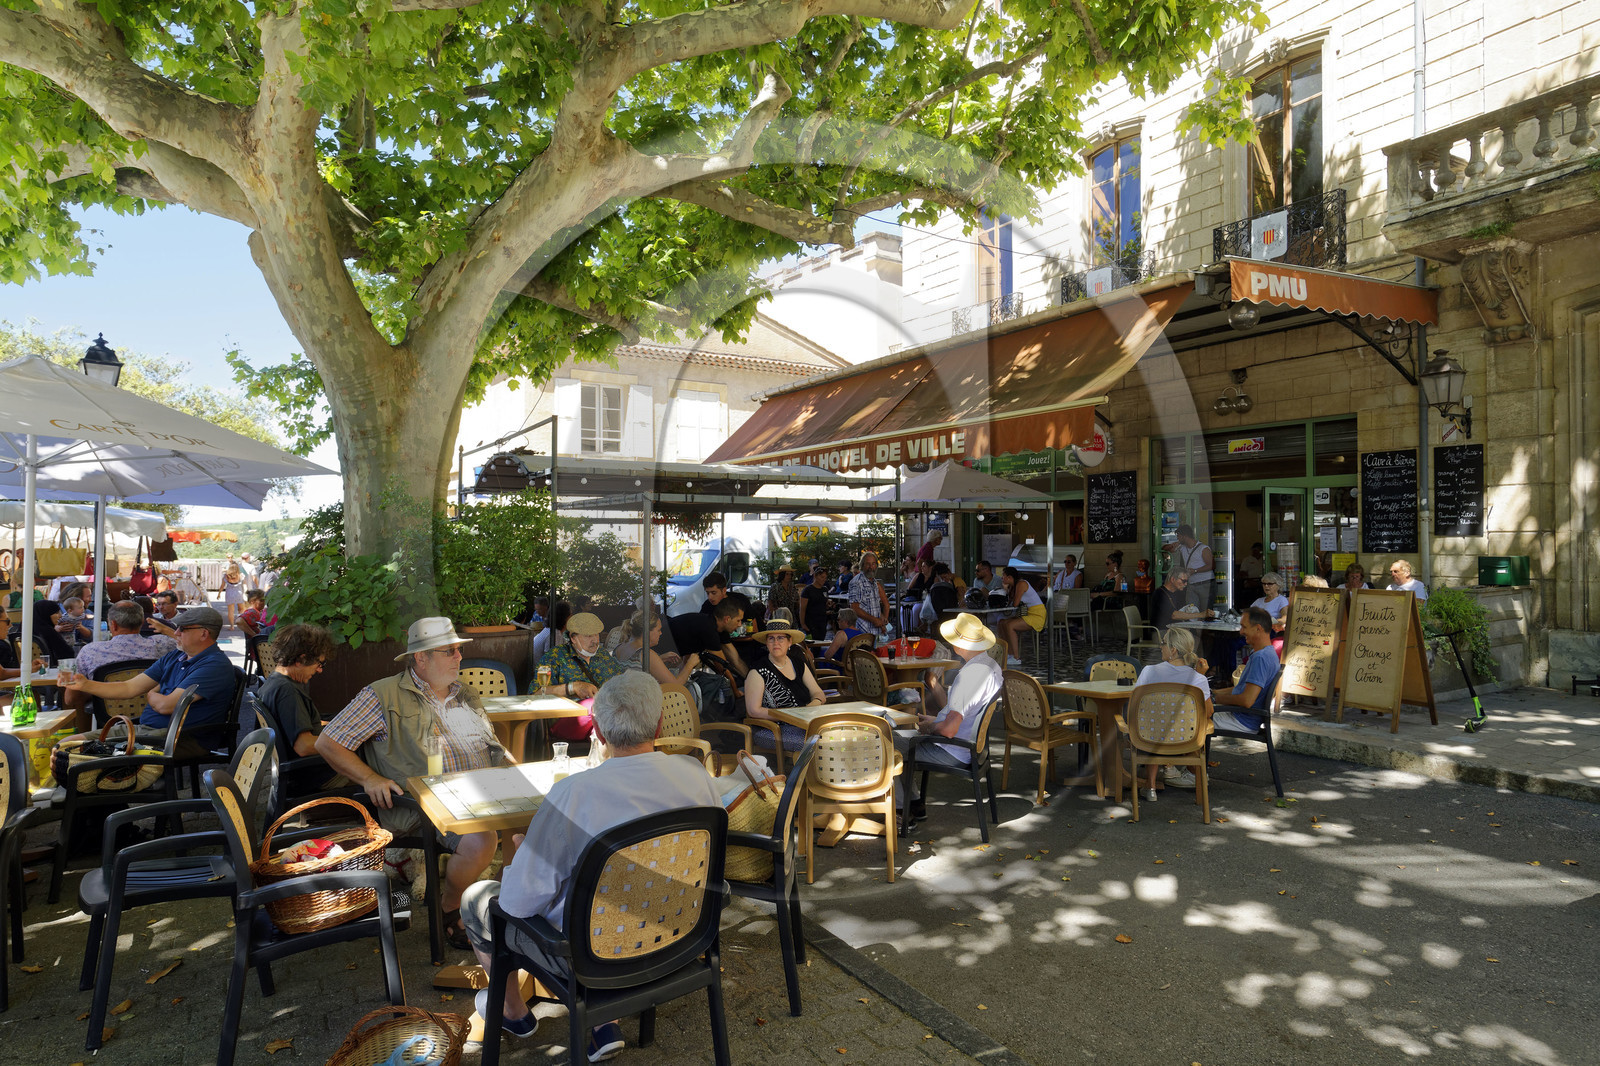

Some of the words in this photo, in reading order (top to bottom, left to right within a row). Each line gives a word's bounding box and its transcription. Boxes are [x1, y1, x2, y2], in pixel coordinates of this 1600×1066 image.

[1250, 271, 1308, 301] PMU
[49, 419, 147, 438] CARTE
[876, 441, 901, 464] DE
[907, 432, 966, 460] VILLE
[1028, 455, 1051, 466] Jouez!
[1366, 453, 1386, 467] Cave
[1385, 456, 1393, 466] à
[1100, 474, 1119, 487] Vin
[1373, 502, 1400, 512] Chouffe
[1370, 521, 1395, 529] Corona
[1358, 602, 1396, 622] Fruits
[1354, 643, 1392, 664] Orange
[1367, 661, 1379, 670] et
[1355, 667, 1383, 684] Citron
